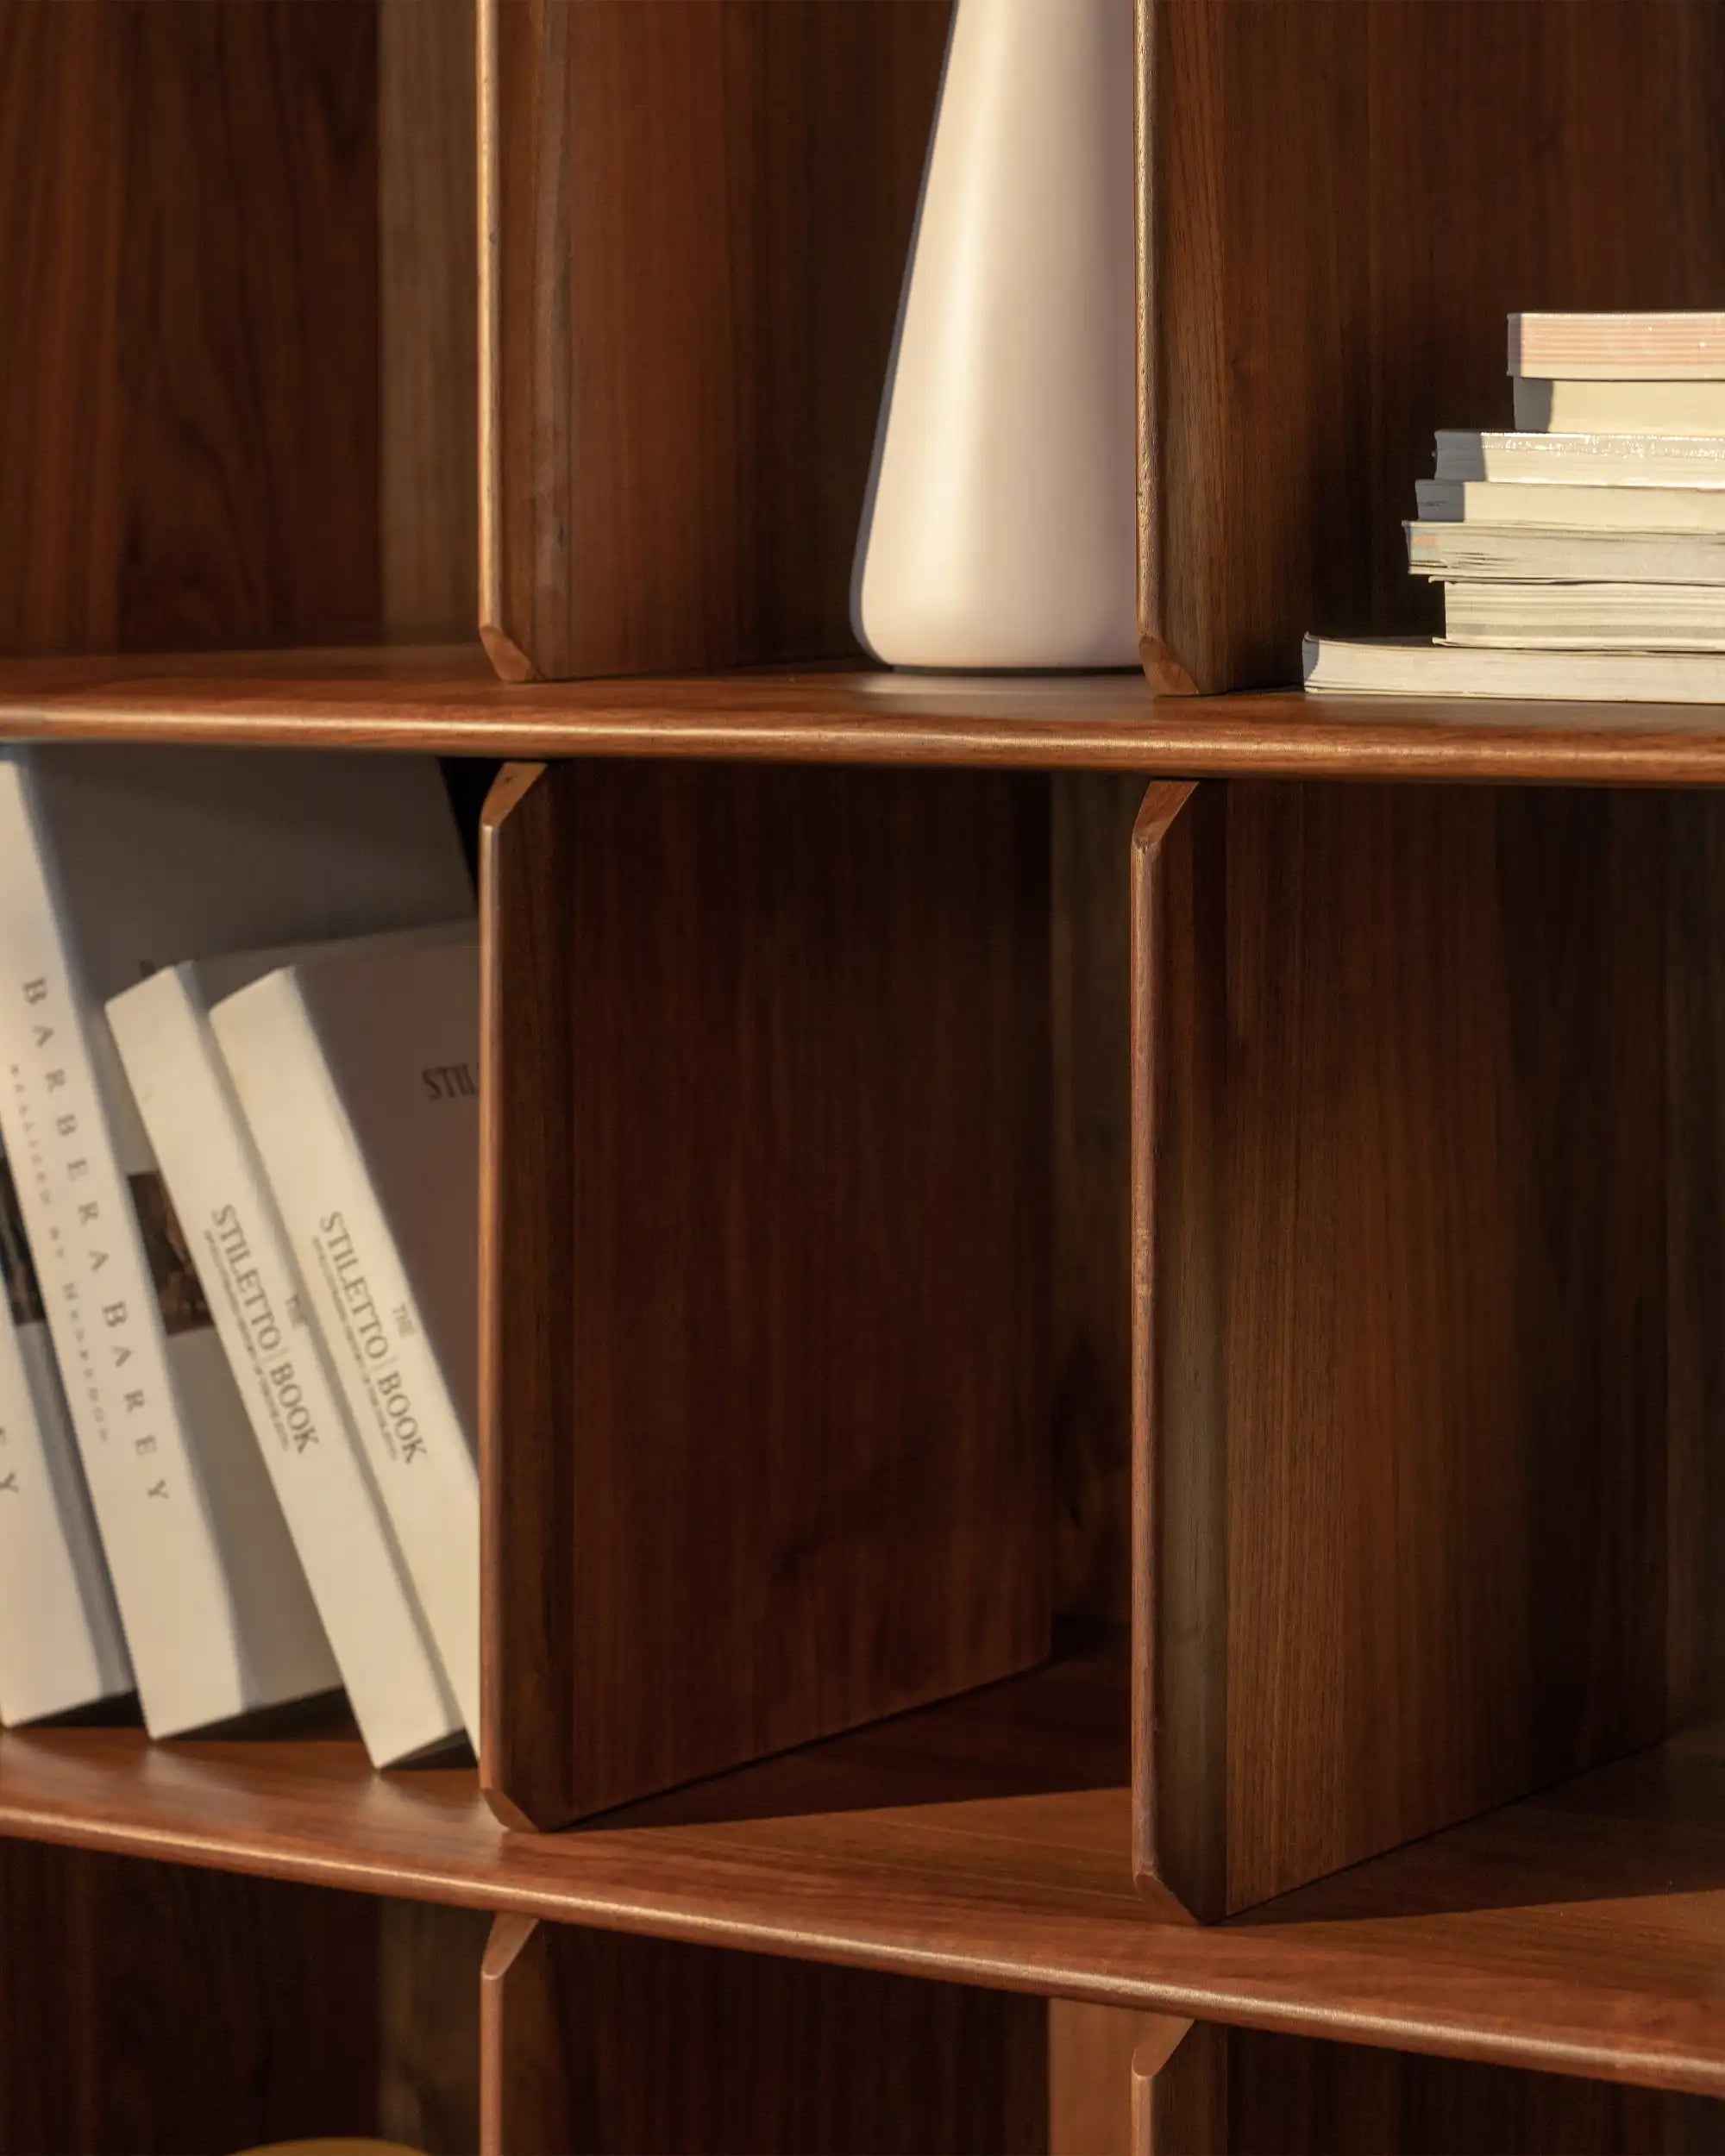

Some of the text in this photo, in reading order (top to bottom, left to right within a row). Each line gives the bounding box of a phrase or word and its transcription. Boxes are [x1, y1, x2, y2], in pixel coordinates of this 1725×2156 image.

[422, 1062, 479, 1100] STIL
[212, 1203, 283, 1351] STILETTO
[269, 1363, 320, 1454] BOOK
[322, 1211, 391, 1359] STILETTO
[377, 1372, 427, 1464] BOOK
